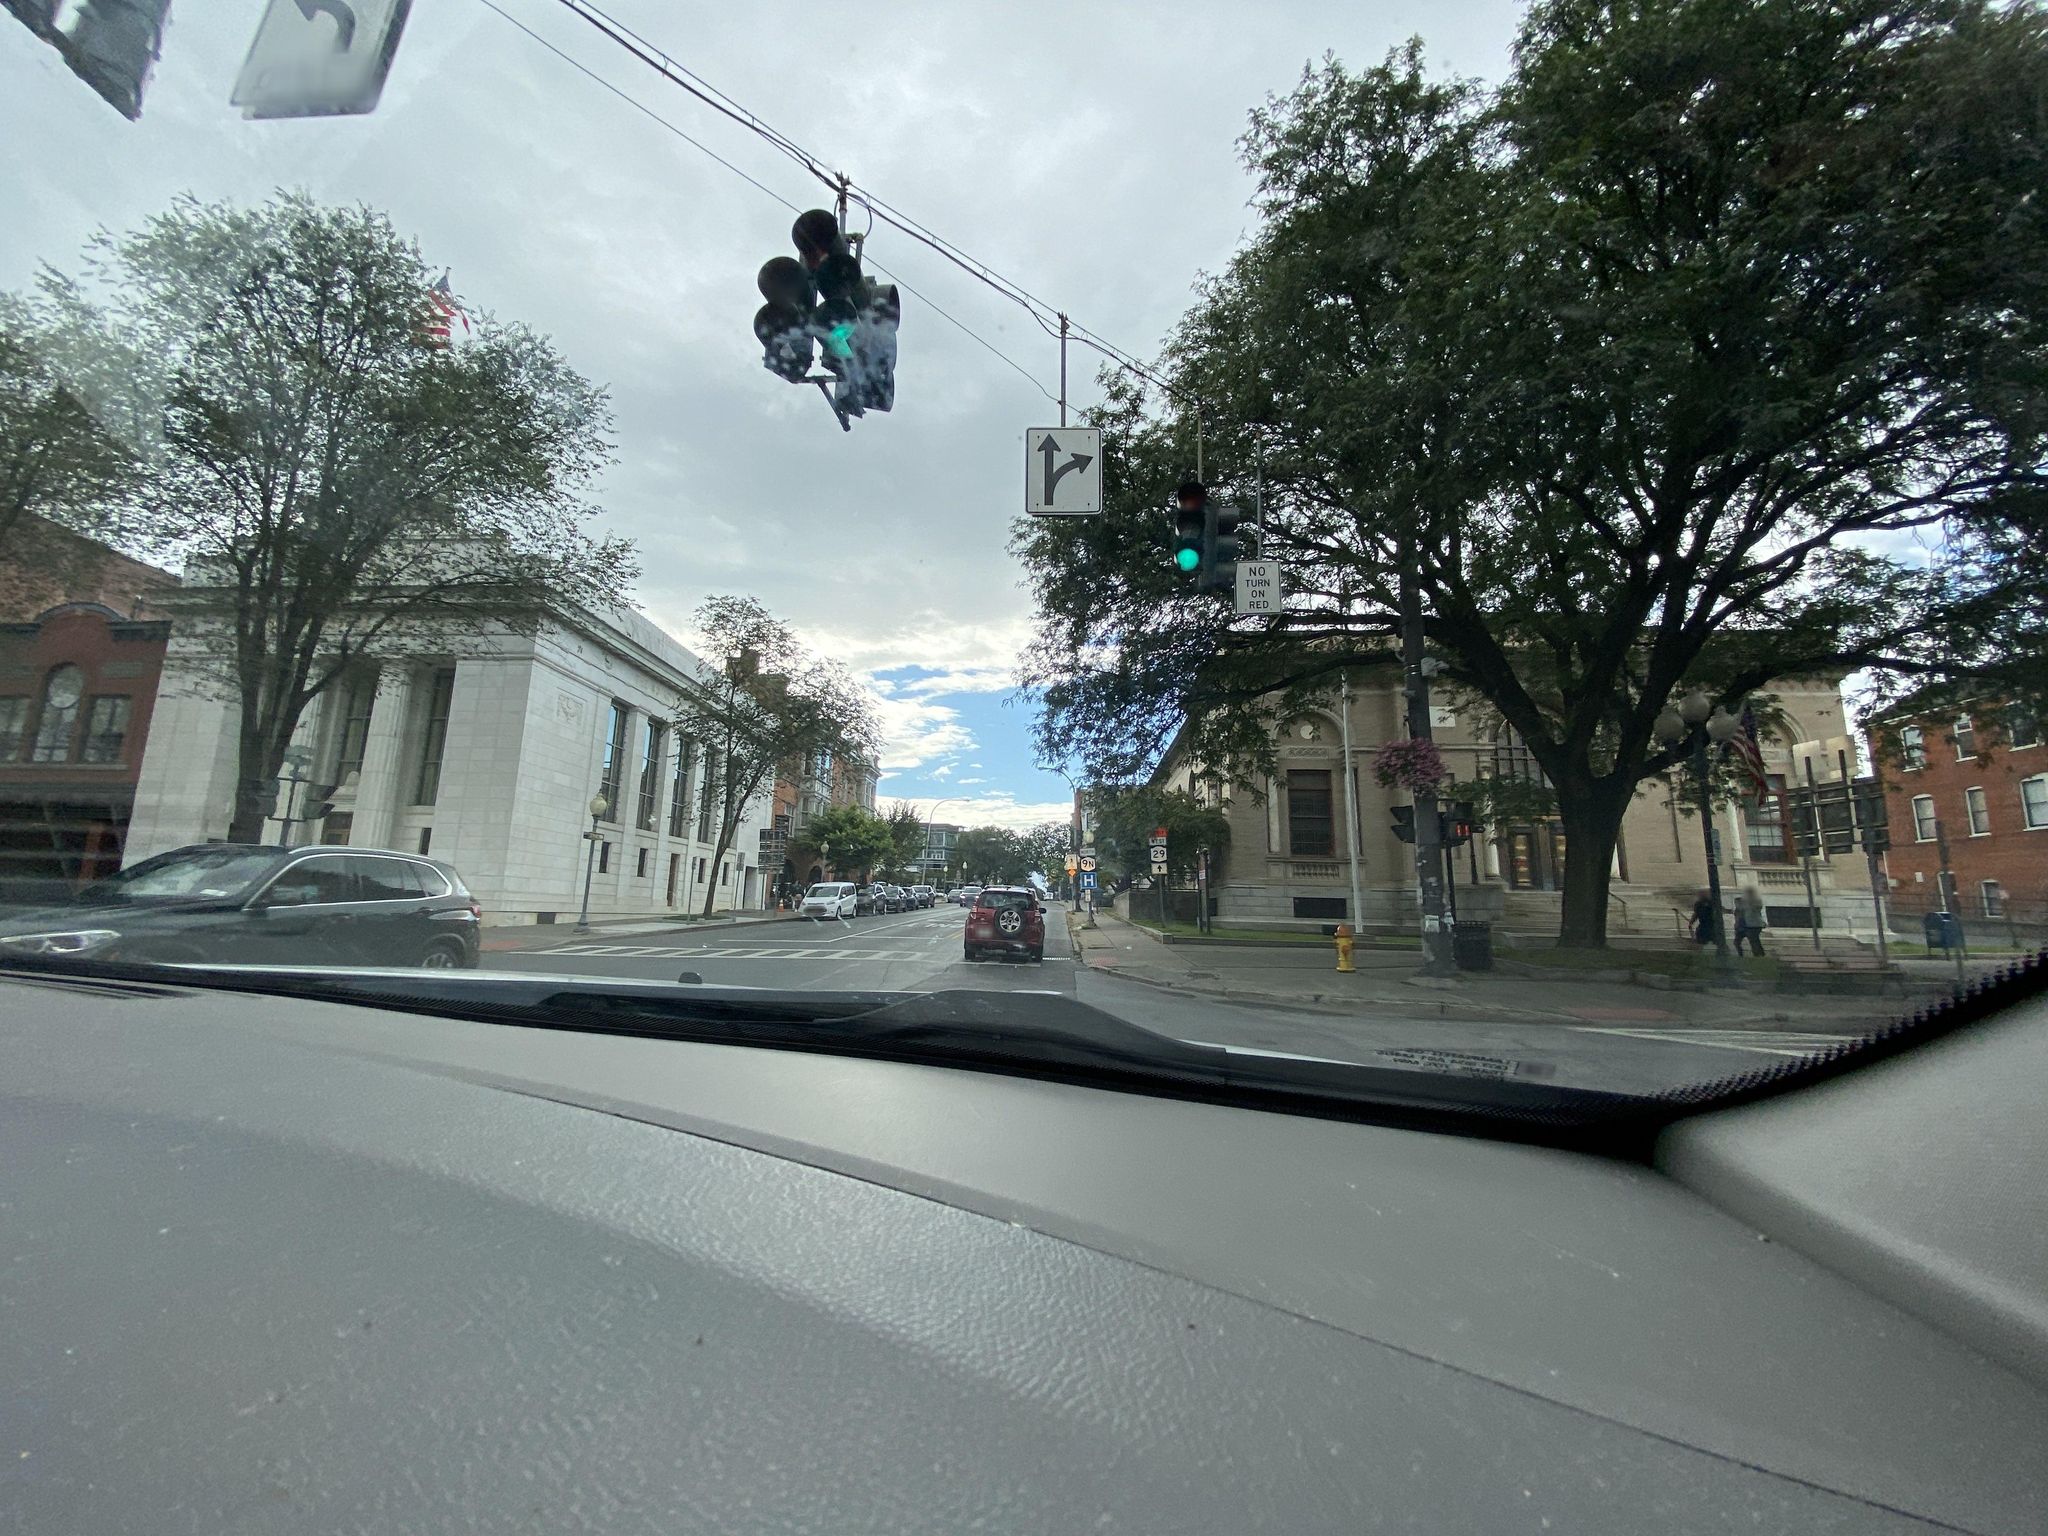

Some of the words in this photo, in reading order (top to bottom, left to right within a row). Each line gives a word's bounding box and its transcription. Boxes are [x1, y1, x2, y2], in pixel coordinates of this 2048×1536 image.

[1249, 566, 1266, 577] NO
[1245, 579, 1271, 588] TURN
[1251, 590, 1265, 599] ON
[1249, 600, 1269, 609] RED
[1153, 849, 1165, 859] 29
[1082, 859, 1094, 868] 9N
[1083, 874, 1094, 887] H
